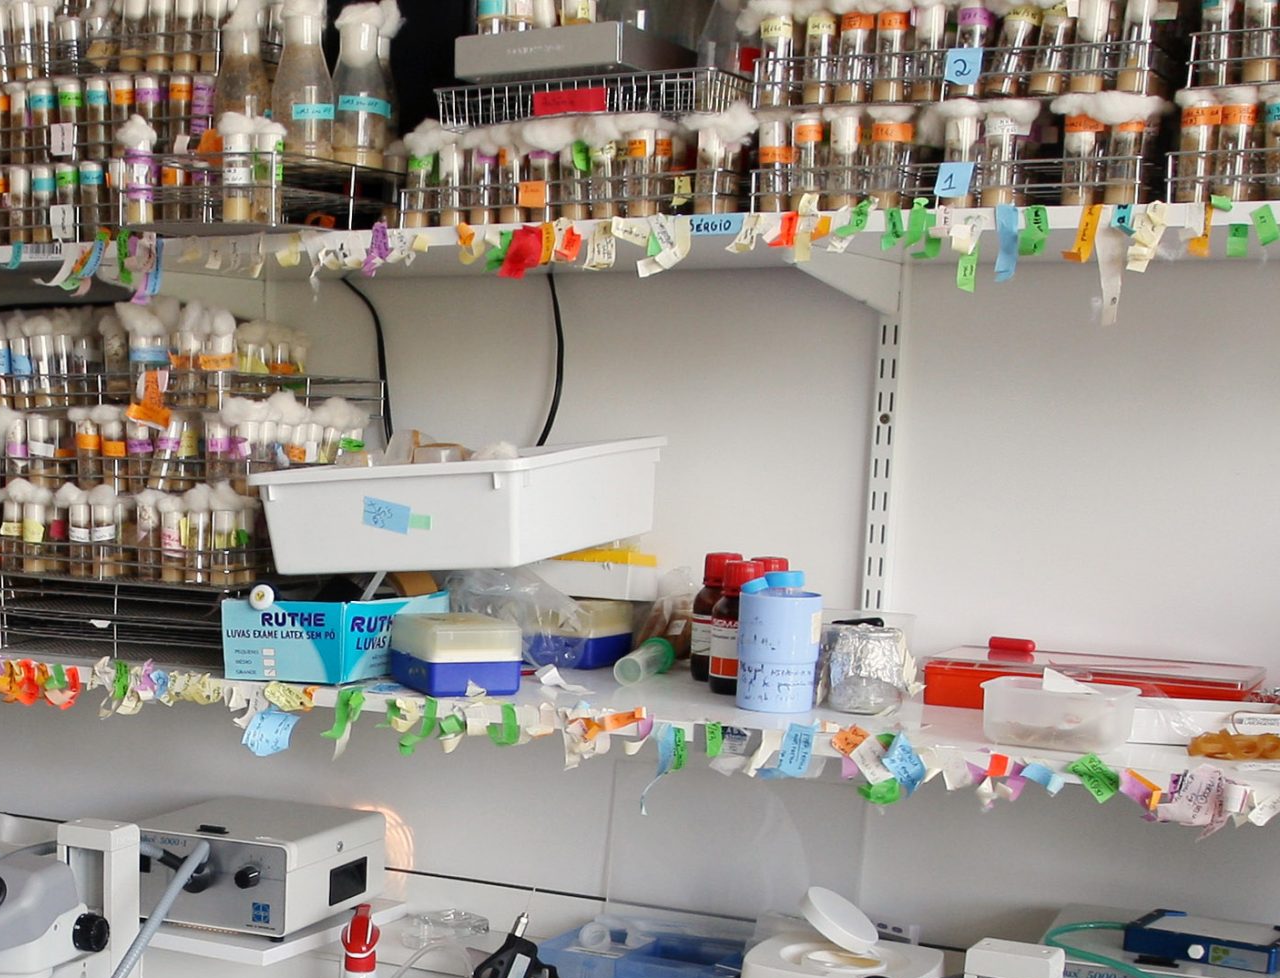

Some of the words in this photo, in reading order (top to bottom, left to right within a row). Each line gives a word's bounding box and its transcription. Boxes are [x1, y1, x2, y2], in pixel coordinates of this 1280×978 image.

[953, 58, 972, 77] 2
[941, 172, 957, 192] 1
[261, 612, 326, 628] RUTHE
[226, 629, 251, 639] LUVAS
[253, 630, 278, 639] EXAME
[280, 631, 304, 640] LATEX
[306, 631, 322, 640] SEM
[324, 629, 336, 640] PÓ
[356, 636, 387, 651] LUVAS
